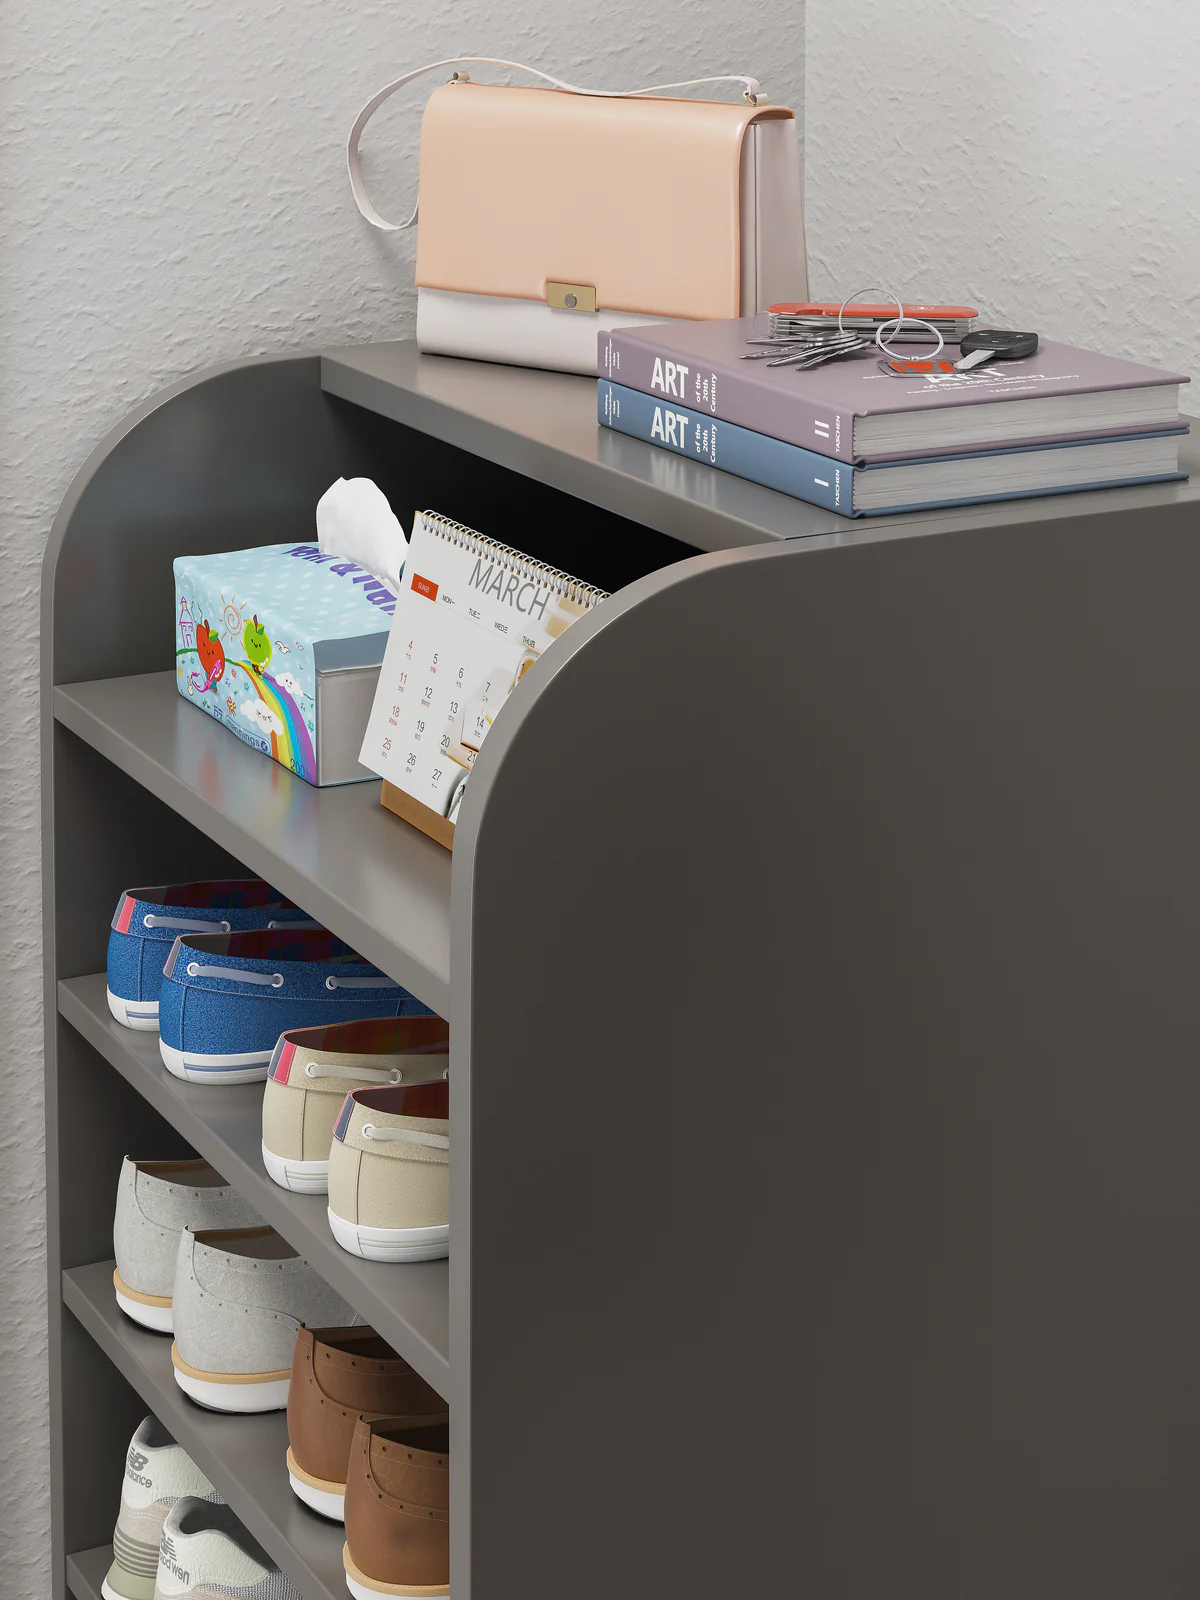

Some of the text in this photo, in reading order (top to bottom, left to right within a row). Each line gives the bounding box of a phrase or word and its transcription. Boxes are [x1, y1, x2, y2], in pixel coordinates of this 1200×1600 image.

[650, 357, 689, 399] ART
[695, 391, 701, 403] of
[710, 373, 718, 412] Century
[650, 406, 689, 449] ART
[695, 441, 701, 453] of
[710, 424, 718, 463] Century
[468, 559, 550, 620] MARCH
[408, 640, 491, 692] 4 5 6 7
[400, 672, 485, 729] 11 12 13 14
[392, 705, 476, 764] 18 19 20 21
[383, 737, 392, 750] 25
[406, 753, 416, 766] 26
[432, 768, 442, 781] 27
